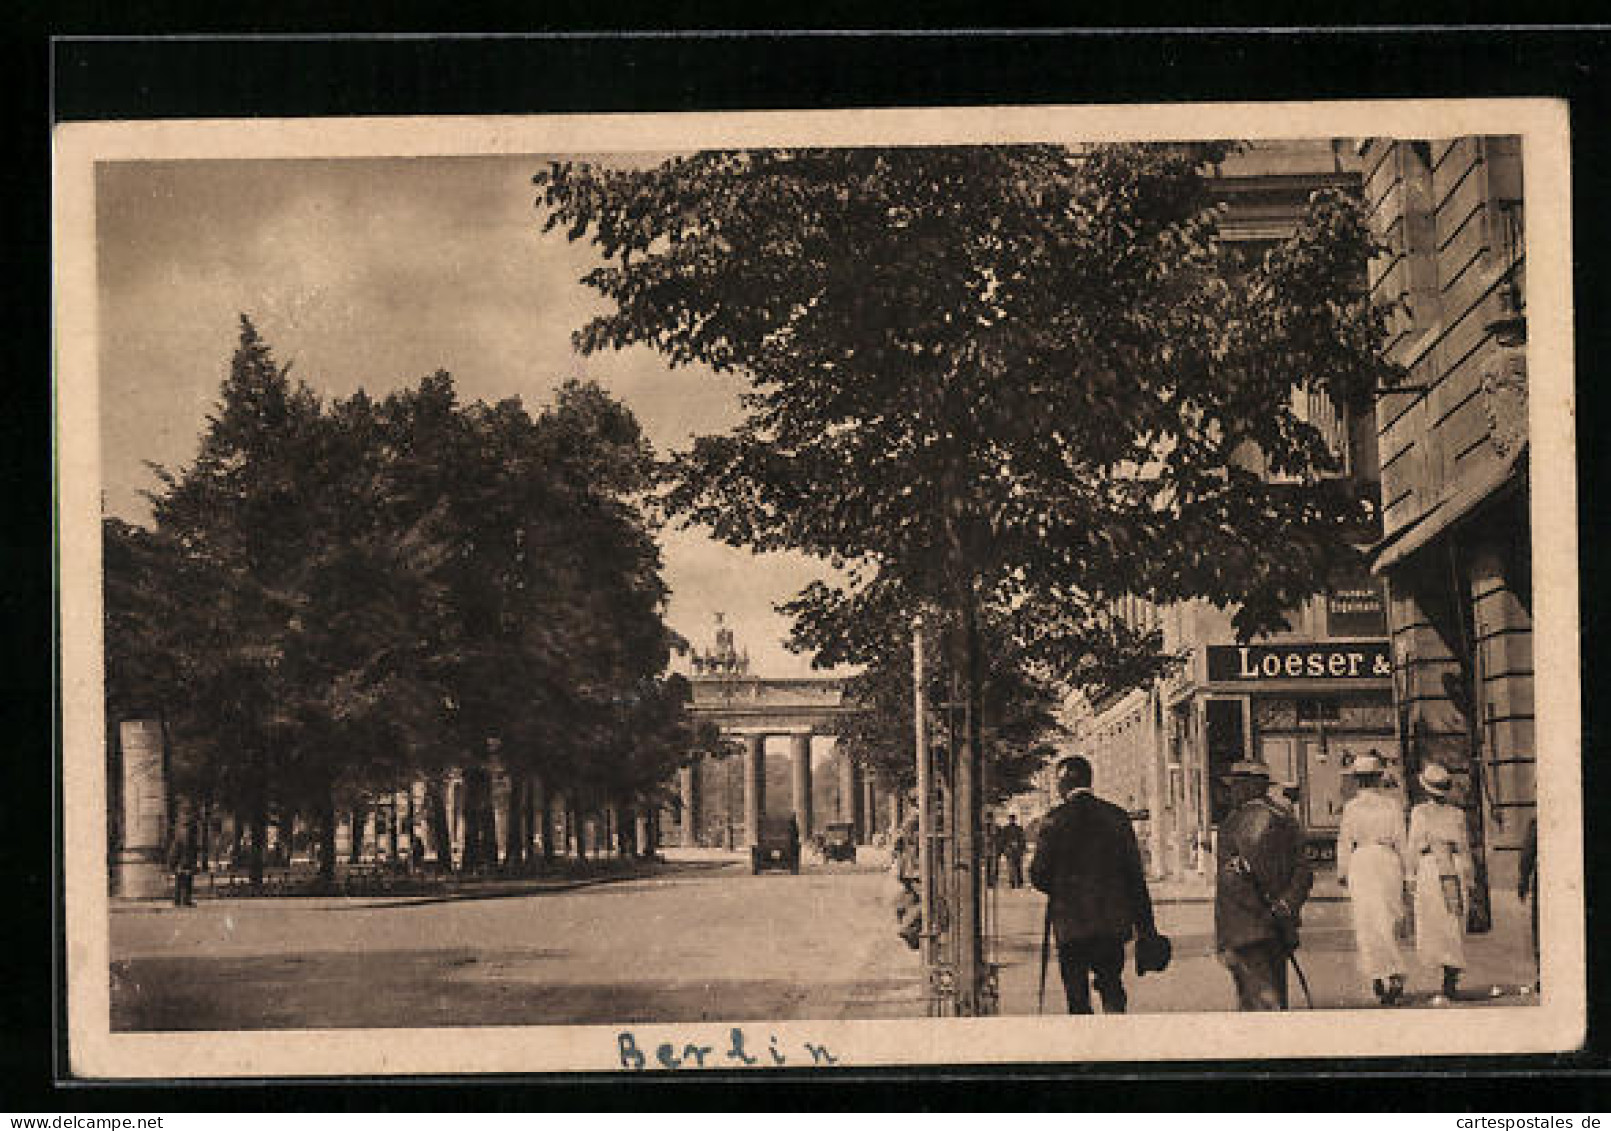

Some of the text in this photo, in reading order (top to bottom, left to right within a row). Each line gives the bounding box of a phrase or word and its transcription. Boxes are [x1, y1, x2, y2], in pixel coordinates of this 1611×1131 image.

[1239, 647, 1391, 677] Loeser &
[617, 1027, 838, 1069] Berlin
